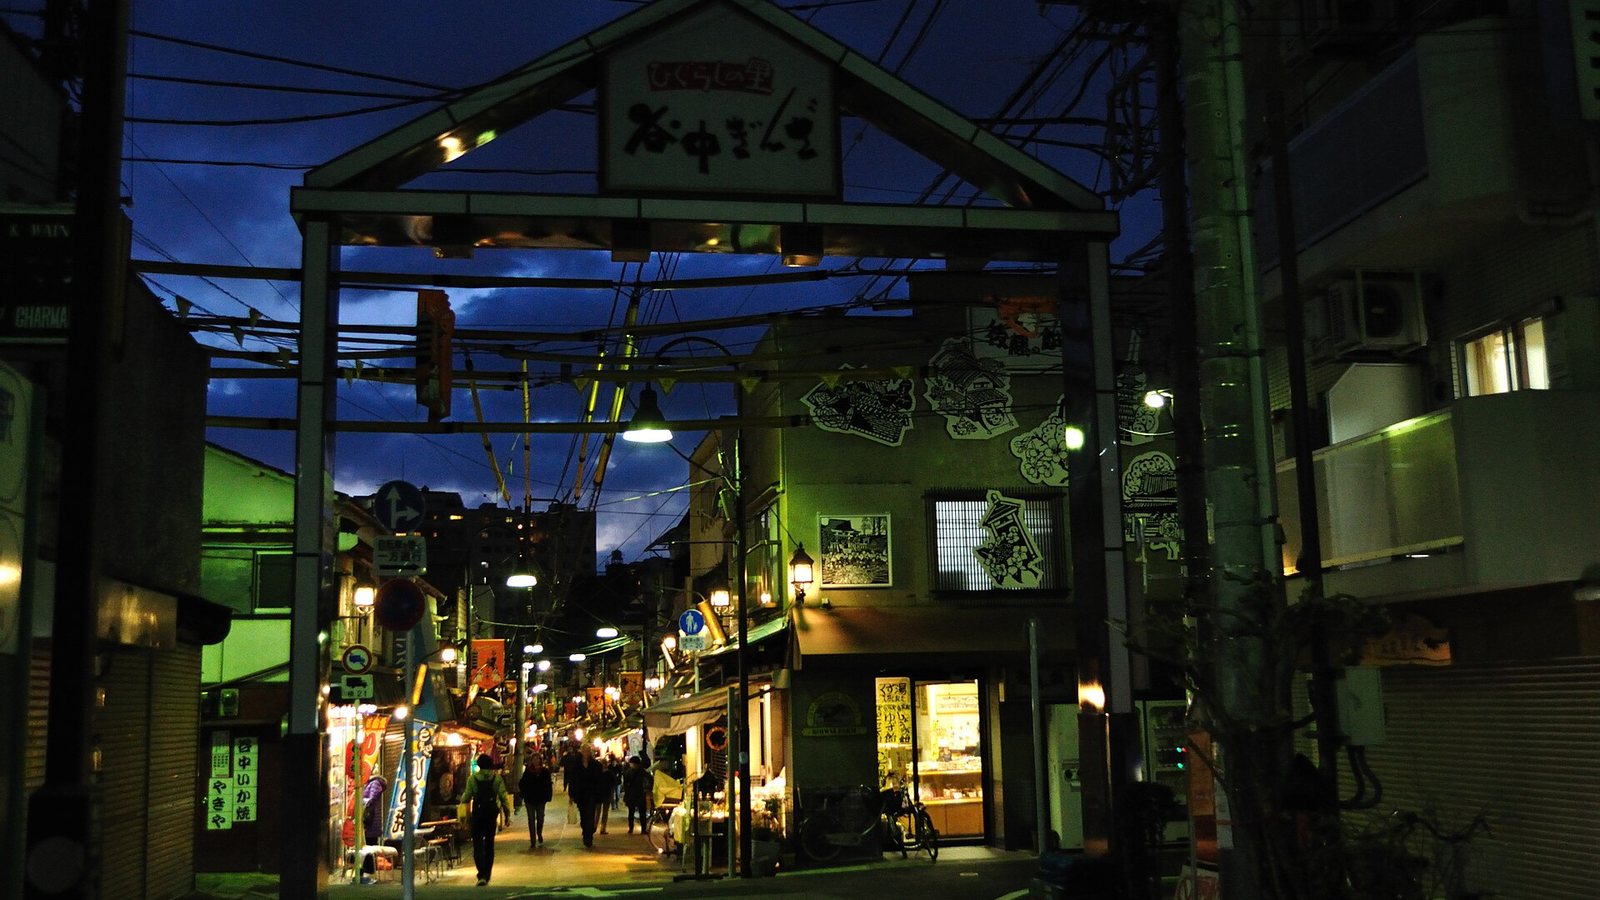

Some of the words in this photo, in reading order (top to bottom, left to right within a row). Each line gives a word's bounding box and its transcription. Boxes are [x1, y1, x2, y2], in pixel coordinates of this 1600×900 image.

[650, 57, 773, 94] ひぐらしの里
[623, 87, 818, 175] 谷中ぎんざ
[211, 780, 227, 828] やきや
[236, 738, 252, 820] 谷中いか焼
